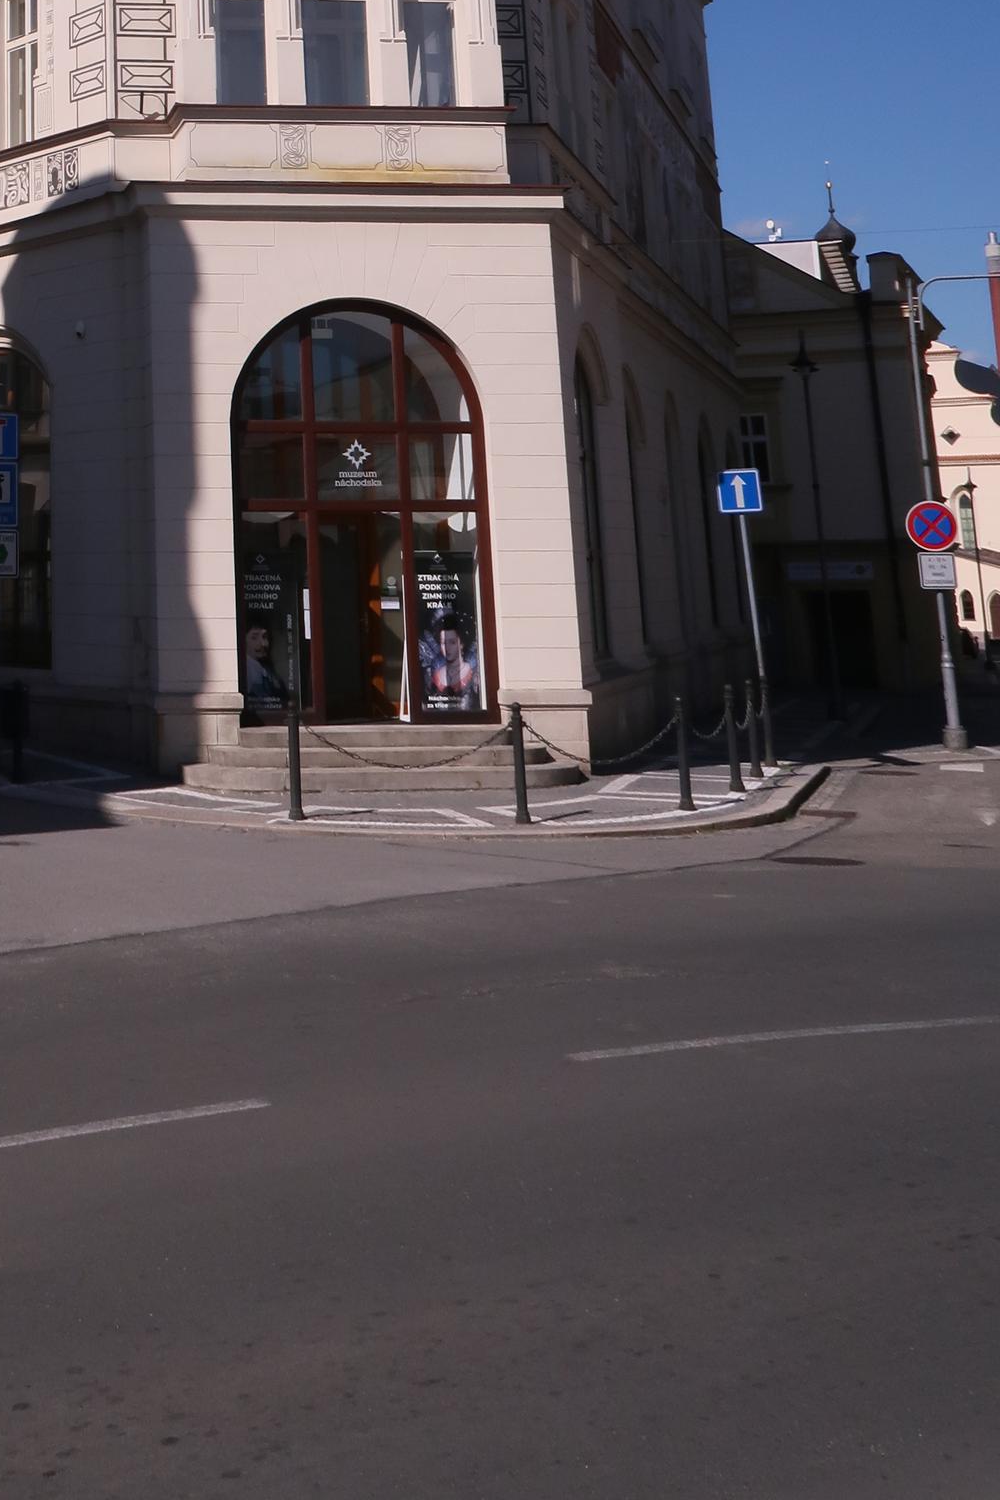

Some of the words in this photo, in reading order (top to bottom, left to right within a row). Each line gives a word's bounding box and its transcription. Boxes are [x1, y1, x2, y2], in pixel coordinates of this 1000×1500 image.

[334, 478, 383, 487] náchodska
[417, 573, 459, 581] ZTRACENÁ
[419, 583, 459, 591] PODKOVA
